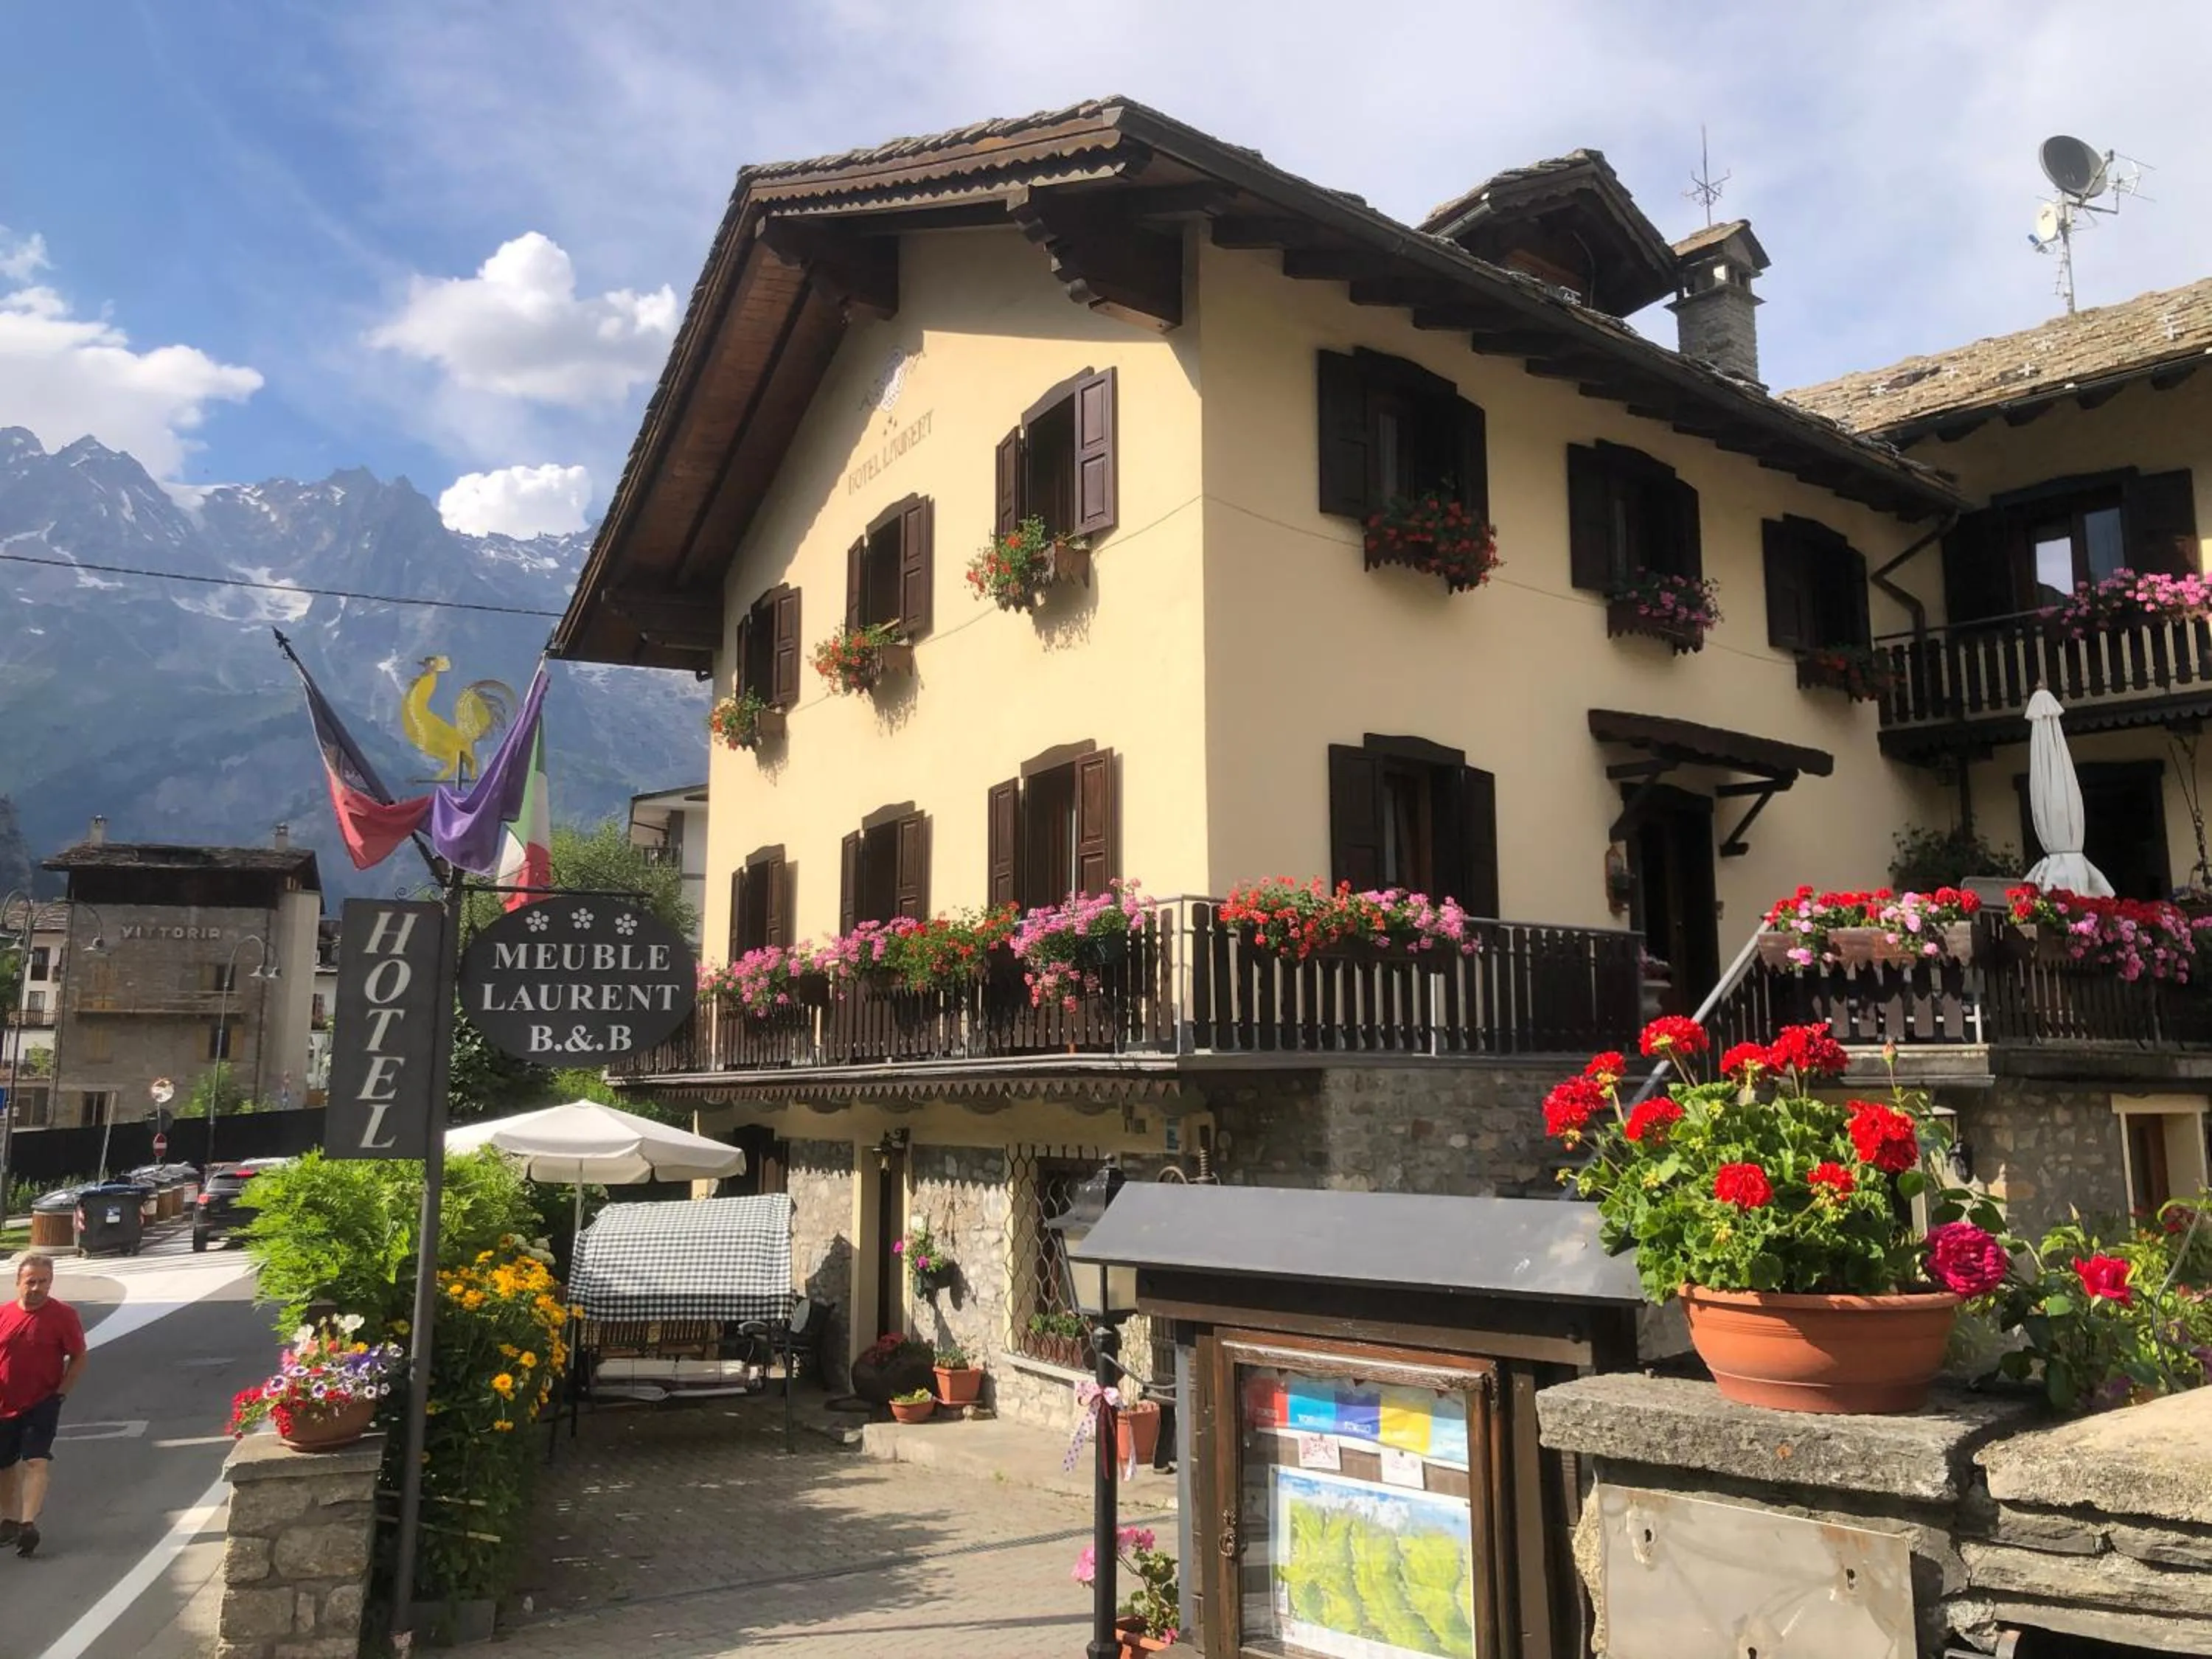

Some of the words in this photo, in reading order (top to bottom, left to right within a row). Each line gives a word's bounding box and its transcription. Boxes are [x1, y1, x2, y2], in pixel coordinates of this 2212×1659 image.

[848, 453, 882, 495] HOTEL
[120, 925, 222, 940] VITTORIA
[492, 942, 671, 971] MEUBLE
[481, 983, 681, 1011] LAURENT
[355, 911, 419, 1149] HOTEL
